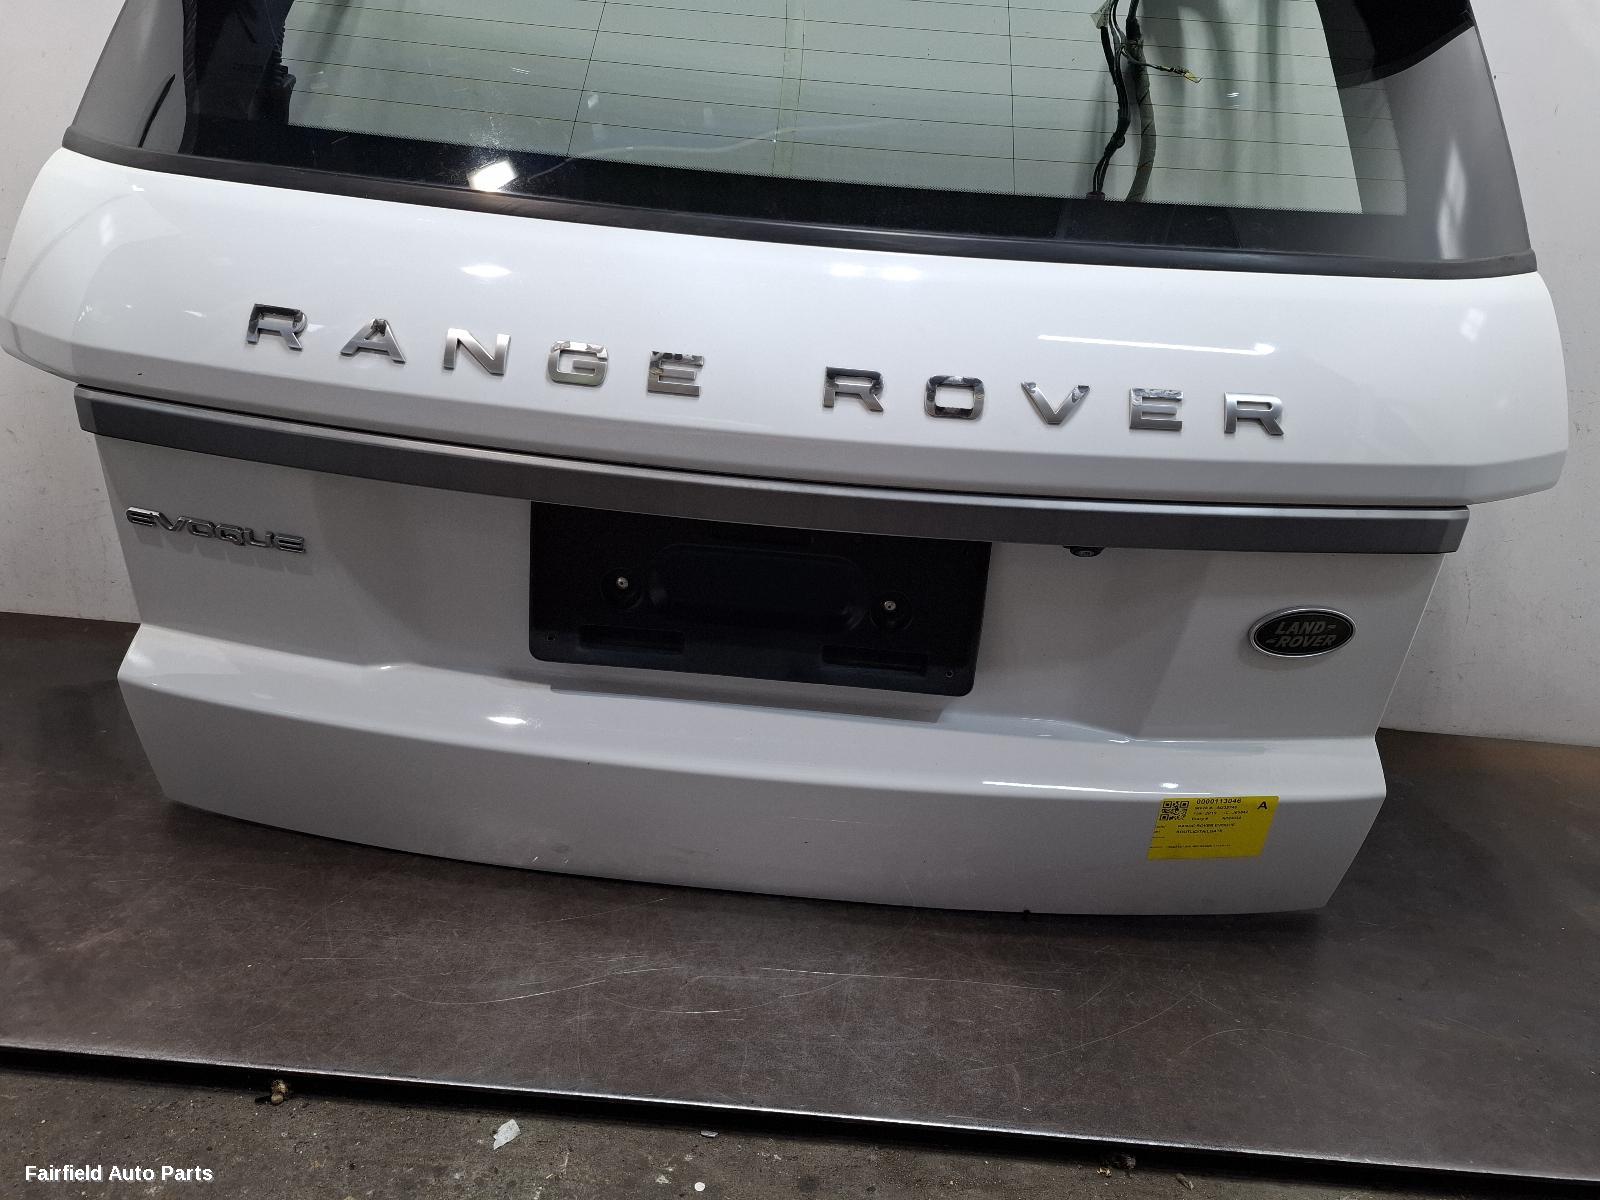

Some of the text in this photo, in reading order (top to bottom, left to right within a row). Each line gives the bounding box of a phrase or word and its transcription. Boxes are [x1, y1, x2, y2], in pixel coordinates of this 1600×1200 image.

[246, 303, 1285, 436] RANGE ROVER
[126, 506, 305, 554] EVOQUE
[1275, 621, 1326, 635] LAND
[1274, 634, 1336, 648] ROVER
[1257, 800, 1268, 810] A
